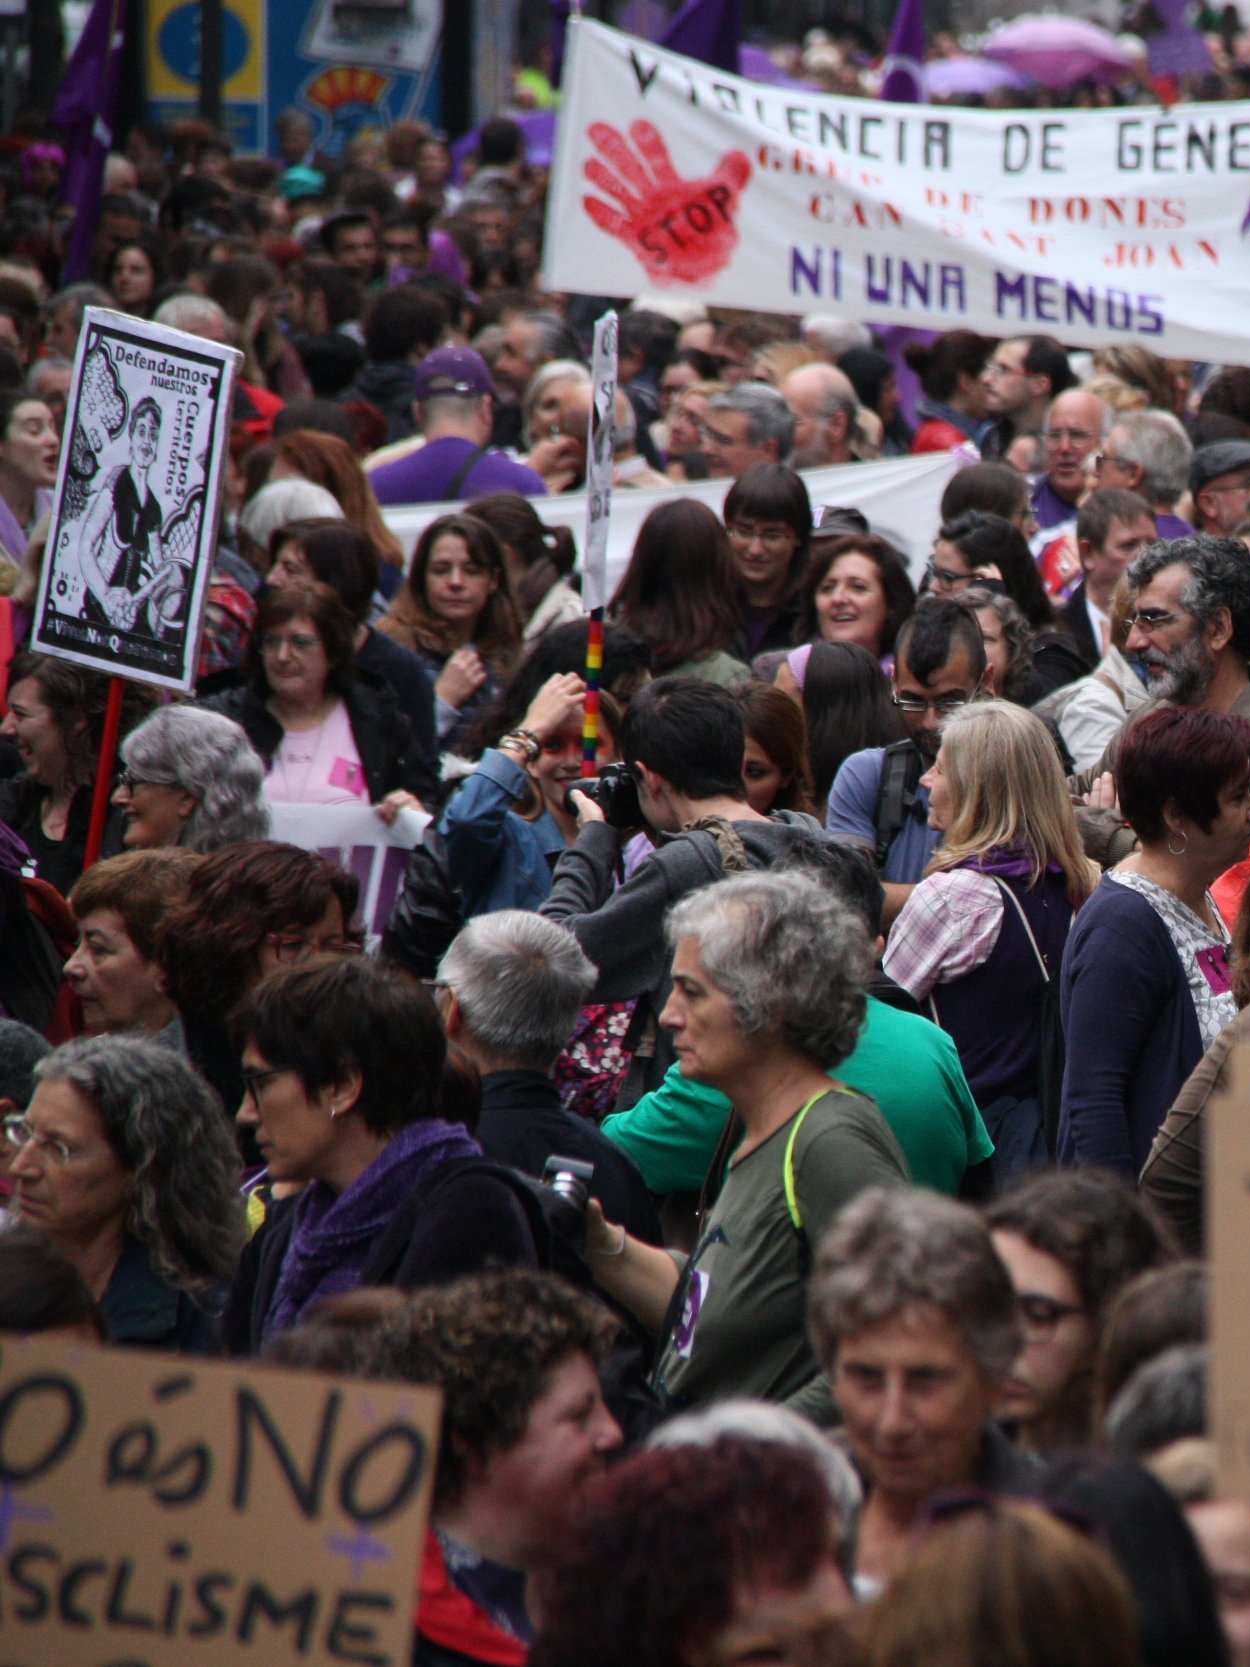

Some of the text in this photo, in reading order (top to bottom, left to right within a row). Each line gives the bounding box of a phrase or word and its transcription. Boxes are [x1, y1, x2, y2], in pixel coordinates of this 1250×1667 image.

[629, 49, 951, 168] VIOLENCIA
[1002, 122, 1065, 175] DE
[638, 185, 731, 264] STOP
[810, 193, 902, 228] CAN
[1104, 238, 1220, 269] JOAN
[924, 186, 984, 217] DE
[1028, 197, 1185, 228] DONES
[791, 245, 1164, 336] NI UNA MENOS
[115, 346, 208, 387] Defendamos
[151, 375, 198, 397] nuestros
[165, 400, 185, 496] territorios
[234, 1384, 428, 1524] NO
